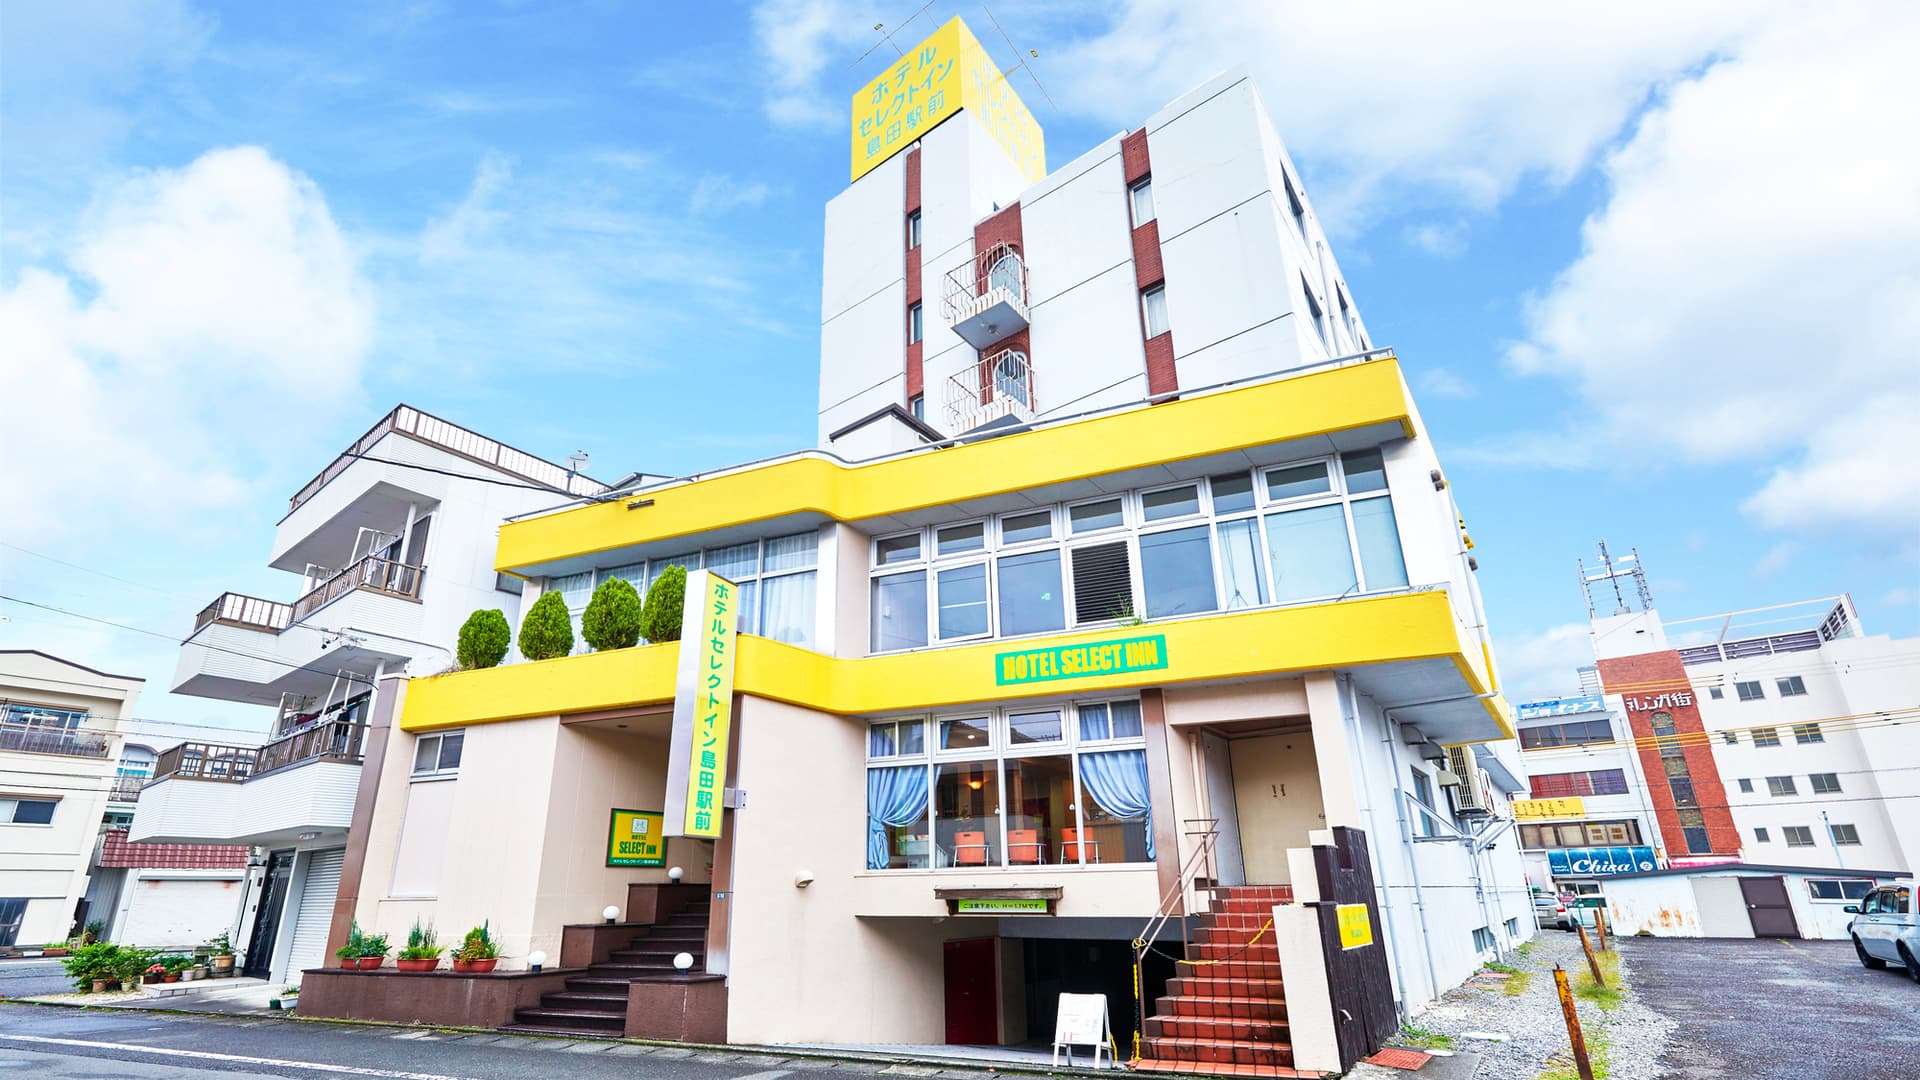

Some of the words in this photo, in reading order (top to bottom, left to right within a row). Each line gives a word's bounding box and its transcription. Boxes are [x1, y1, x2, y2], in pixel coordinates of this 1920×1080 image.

[858, 58, 954, 138] セレクトイン
[871, 47, 937, 105] ホテル
[865, 89, 945, 159] 島田駅前
[1003, 651, 1060, 681] HOTEL
[1060, 643, 1122, 675] SELECT
[1125, 639, 1159, 668] INN
[694, 583, 730, 832] ホテルセレクトイン島田駅前
[618, 841, 646, 854] SELECT
[1572, 859, 1633, 873] Chisa
